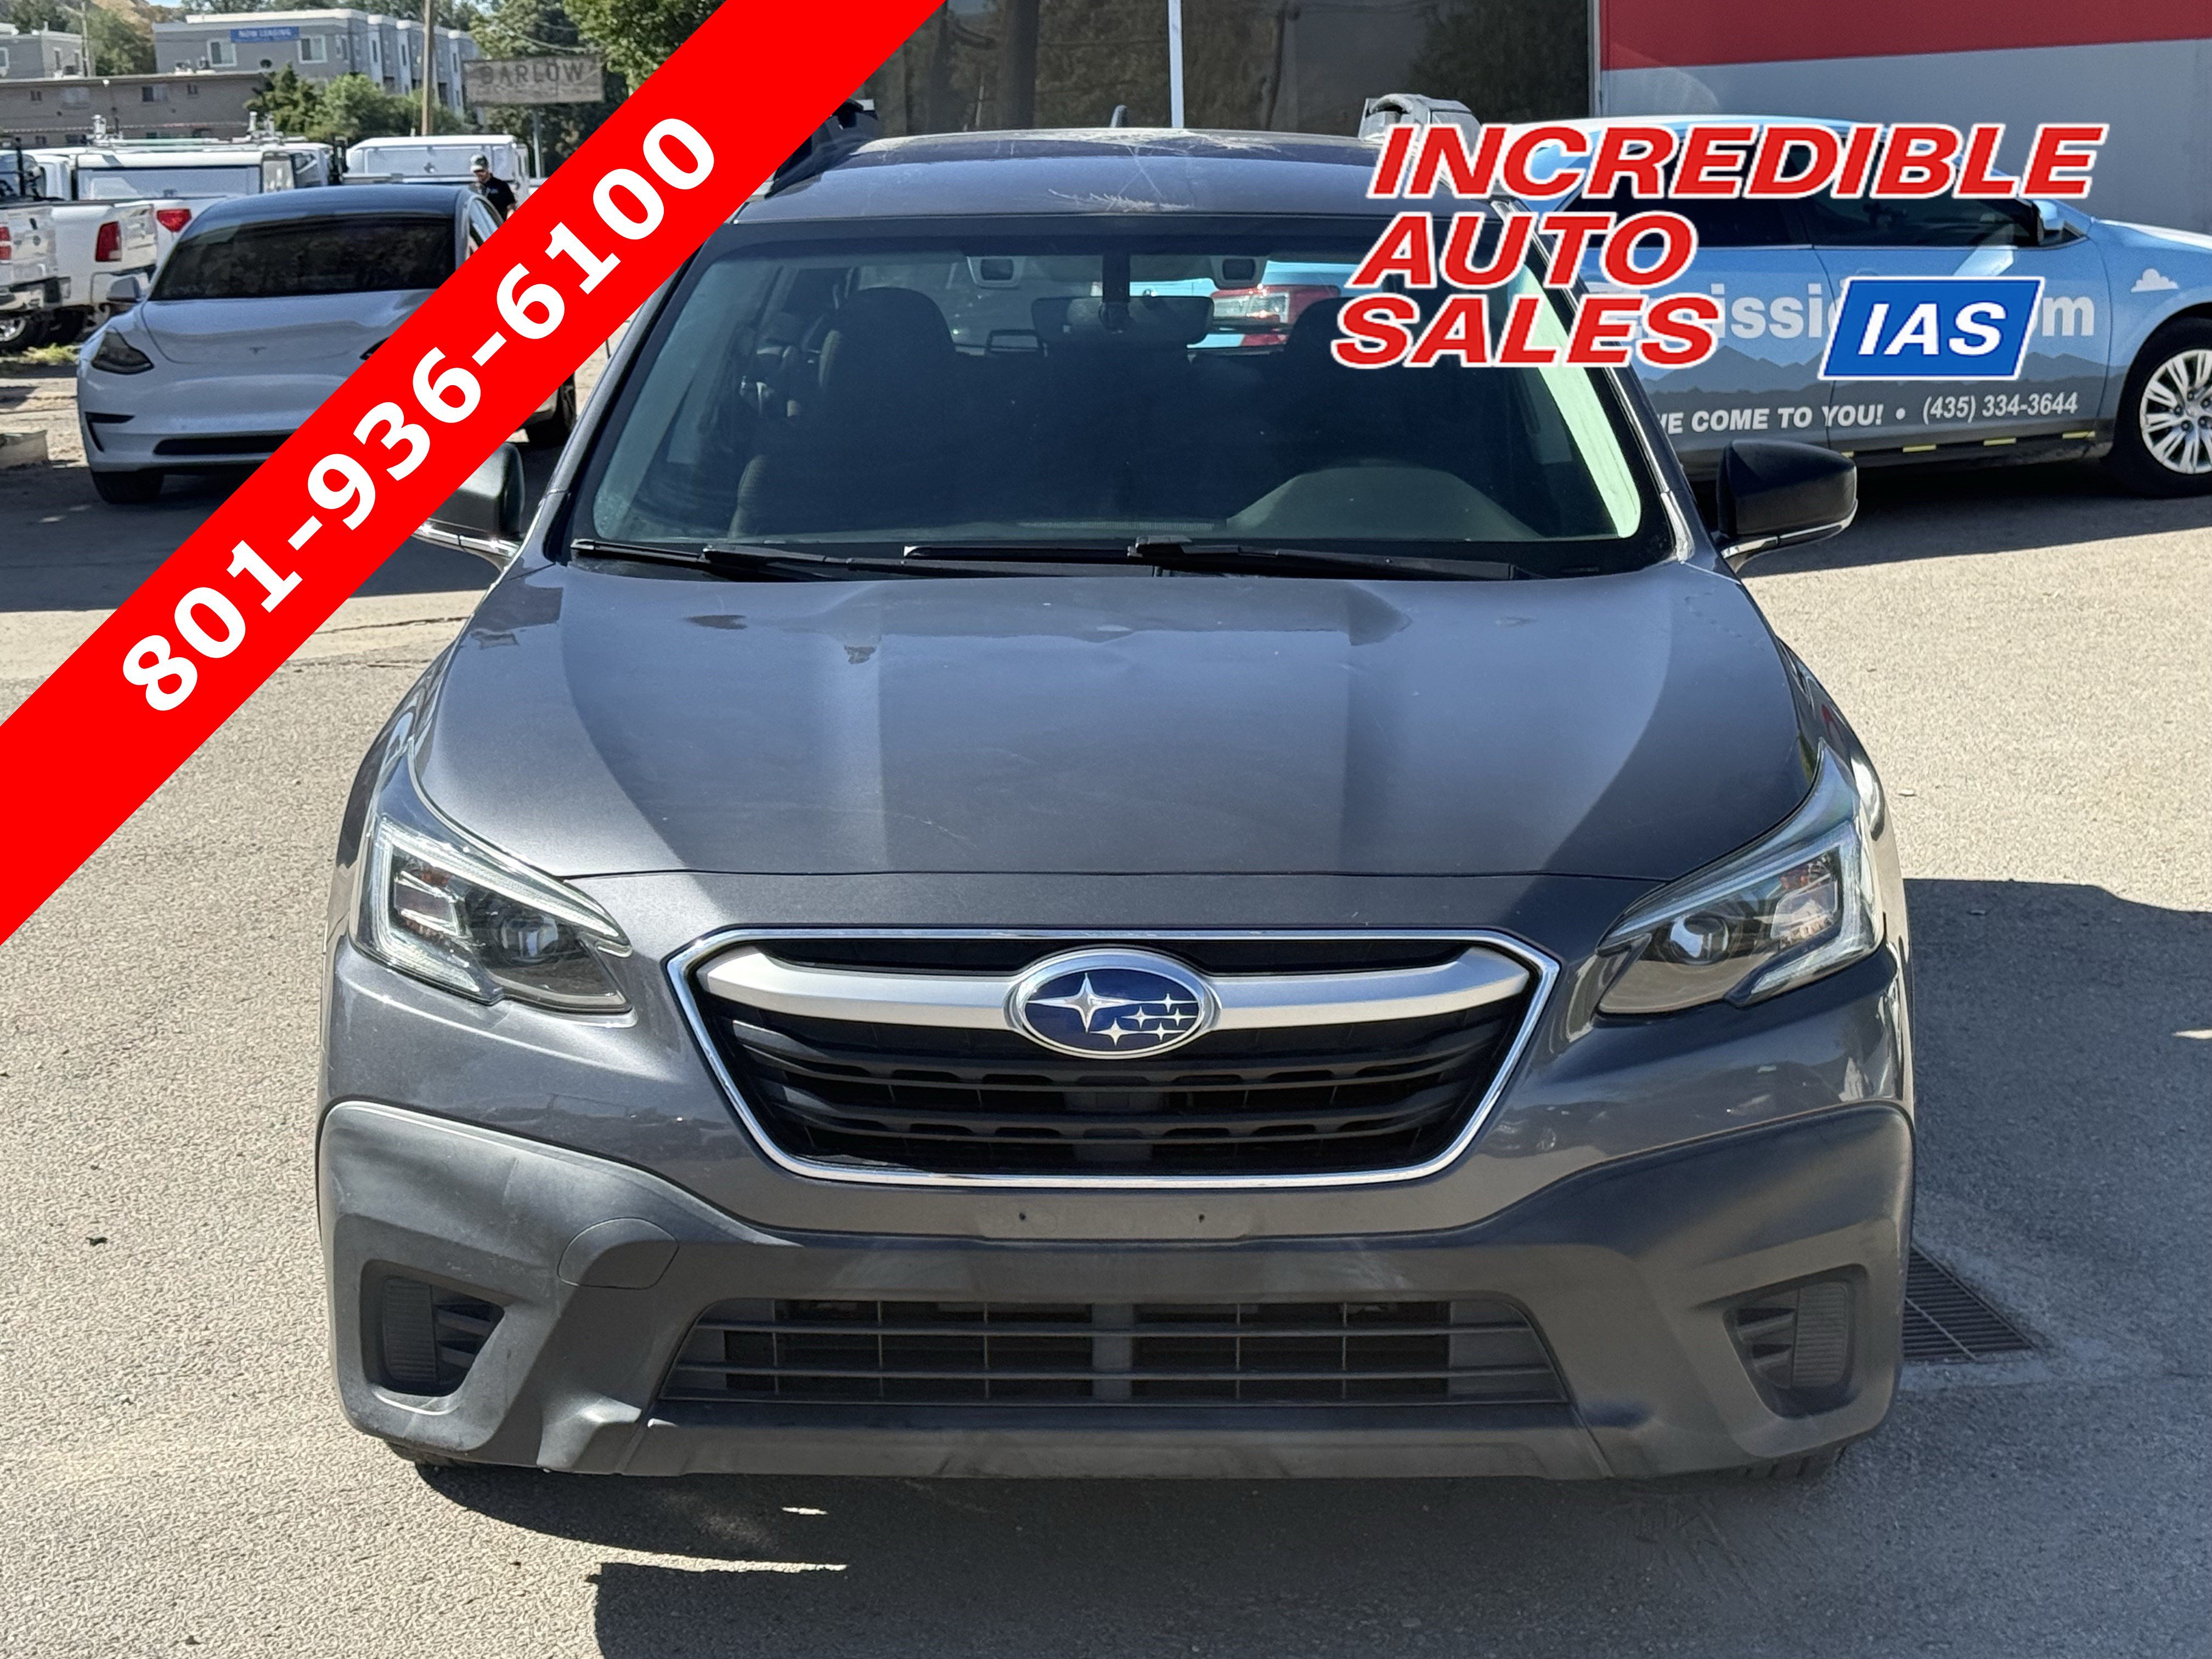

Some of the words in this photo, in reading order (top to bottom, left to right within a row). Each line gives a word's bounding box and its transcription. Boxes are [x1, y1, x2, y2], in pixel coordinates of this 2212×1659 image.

[1691, 408, 1770, 433] COME
[1778, 406, 1813, 429] TO
[1822, 404, 1884, 427] YOU!
[1923, 395, 1976, 425] (435)
[1982, 391, 2078, 417] 334-3644
